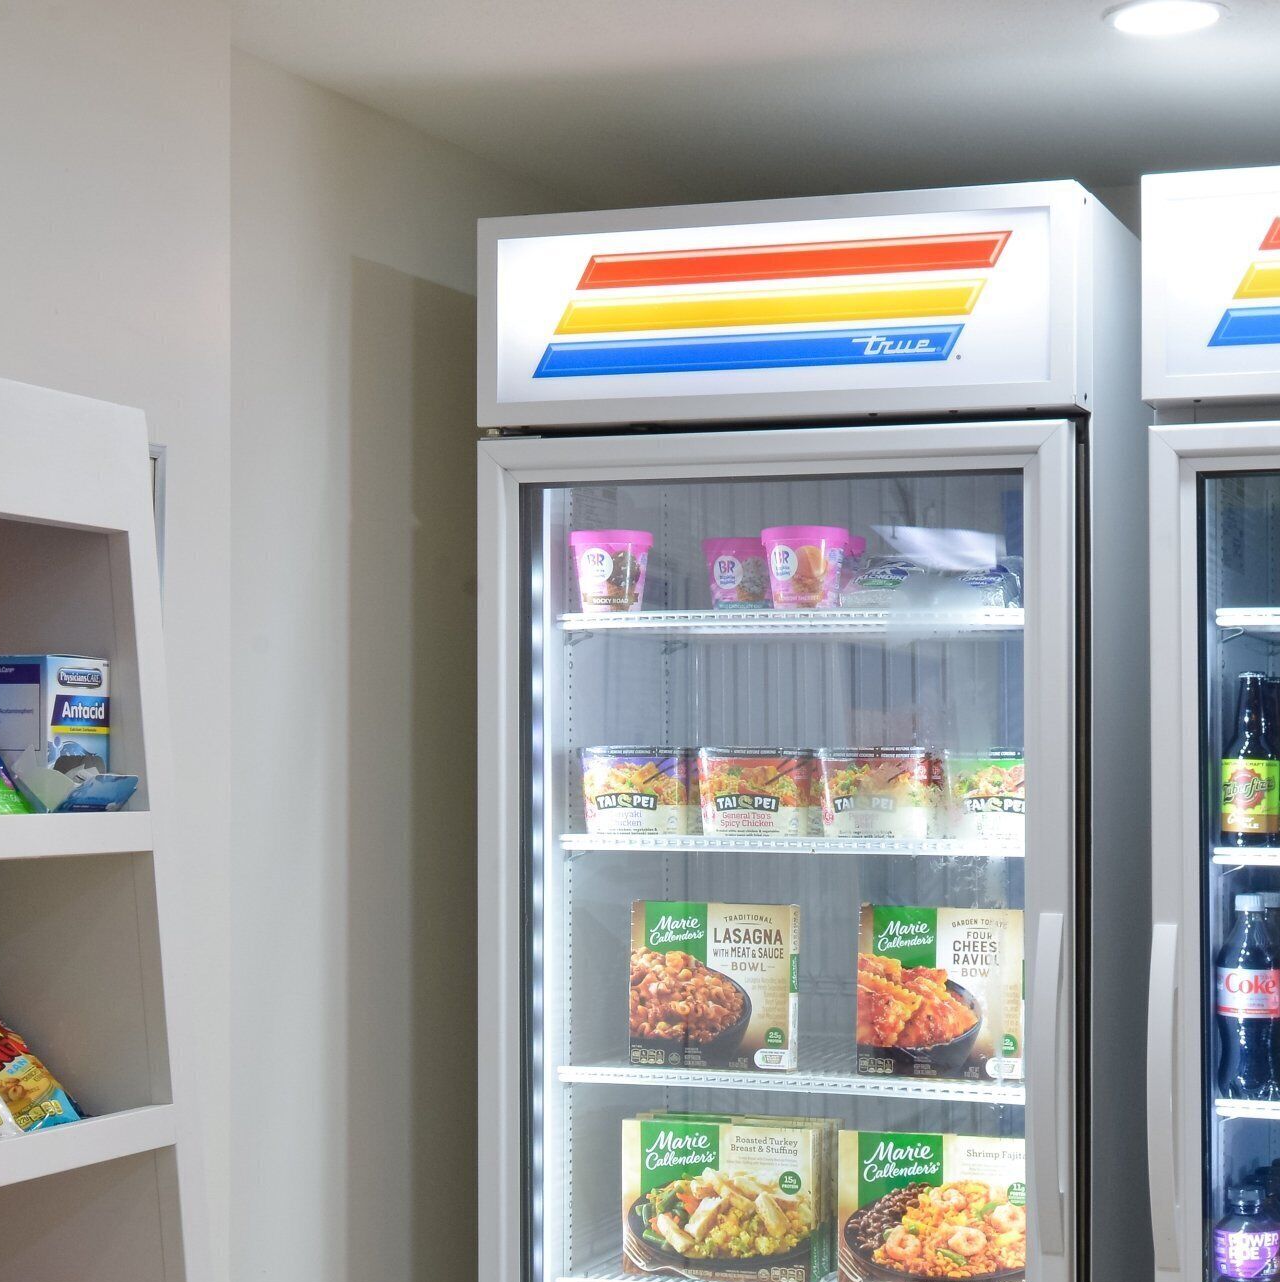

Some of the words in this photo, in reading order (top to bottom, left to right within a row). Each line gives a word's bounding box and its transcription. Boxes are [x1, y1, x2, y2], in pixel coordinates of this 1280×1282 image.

[852, 335, 936, 356] true
[718, 560, 736, 574] BR
[62, 701, 105, 720] Antacid
[597, 795, 617, 808] TAI
[632, 795, 656, 808] PEI
[717, 797, 737, 810] TAI
[754, 798, 776, 810] PEI
[720, 820, 740, 828] Spicy
[650, 915, 701, 933] Marie
[724, 914, 773, 924] TRADITIONAL
[714, 928, 783, 945] LASAGNA
[878, 921, 930, 938] Marie
[966, 932, 993, 940] FOUR
[650, 930, 704, 946] Callender's
[878, 935, 934, 952] Callender's
[713, 949, 730, 957] WITH
[731, 947, 750, 958] MEAT
[751, 950, 757, 958] &
[758, 948, 784, 959] SAUCE
[731, 962, 767, 972] BOWL
[1224, 971, 1276, 996] Coke
[768, 1031, 781, 1040] 25g
[646, 1131, 710, 1153] Marie
[736, 1135, 768, 1145] Roasted
[770, 1137, 798, 1147] Turkey
[731, 1144, 756, 1153] Breast
[765, 1145, 798, 1156] Stuffing
[864, 1141, 934, 1164] Marie
[646, 1151, 717, 1170] Callender's
[863, 1162, 939, 1182] Callender's
[783, 1176, 797, 1185] 15g
[1228, 1233, 1279, 1247] POWER
[1228, 1246, 1260, 1260] ADE
